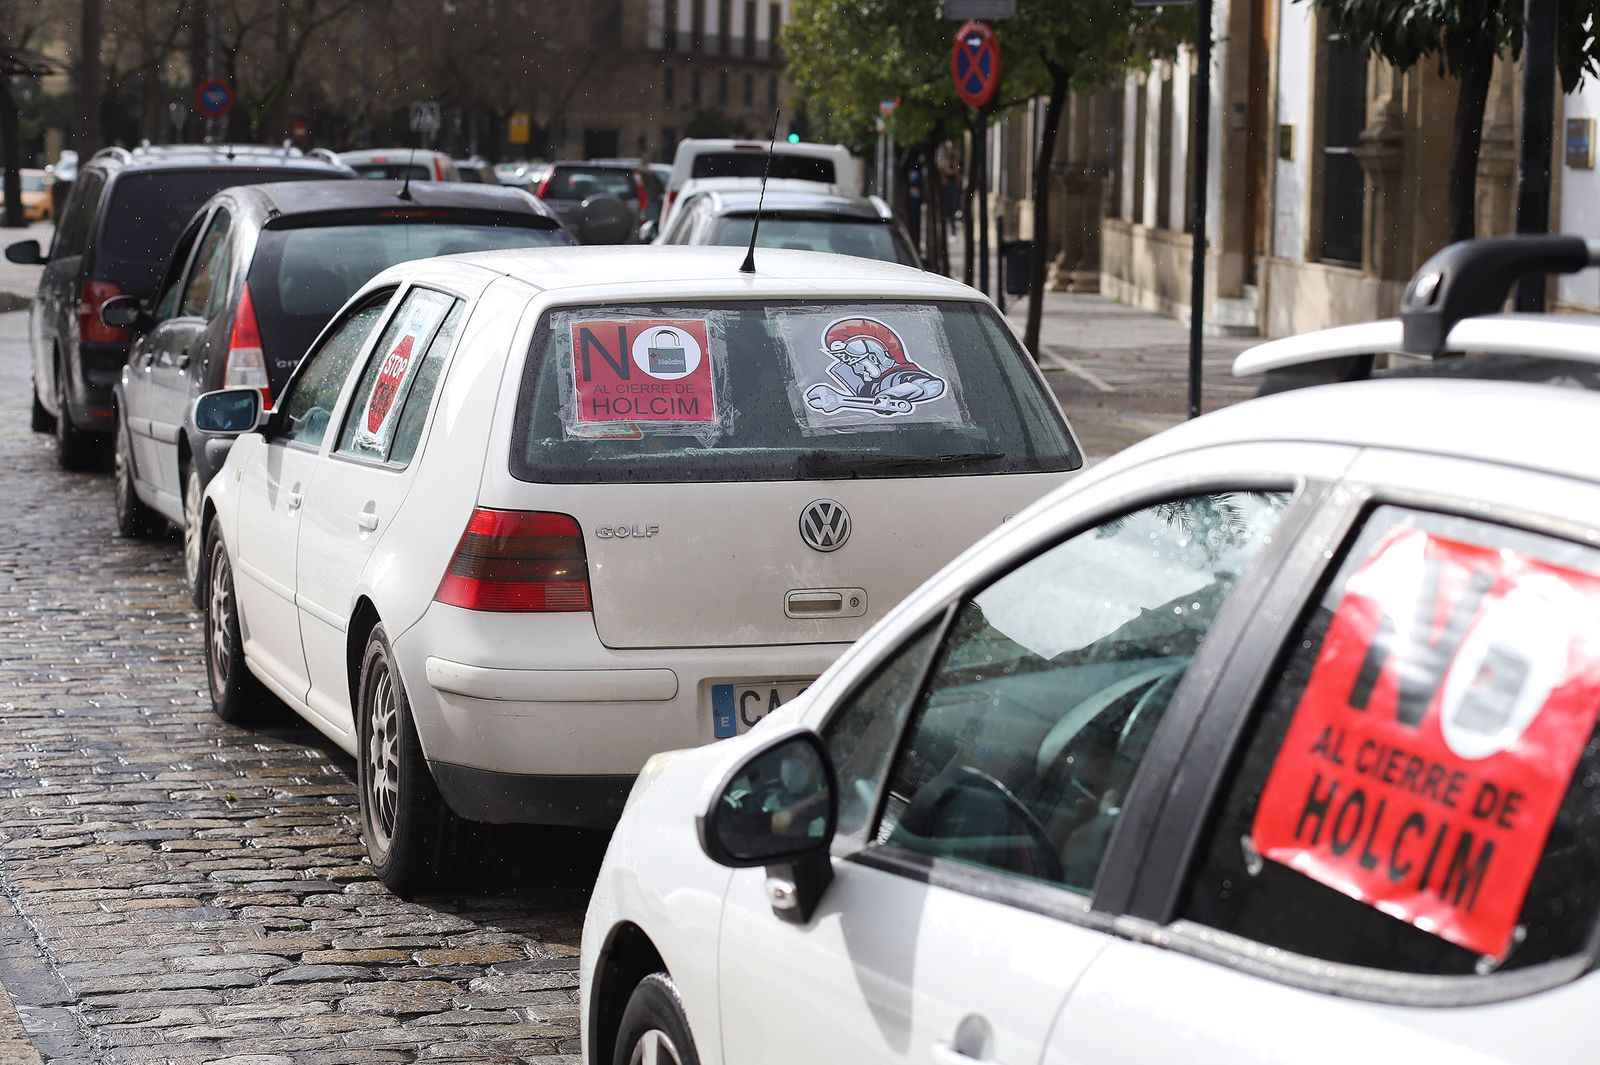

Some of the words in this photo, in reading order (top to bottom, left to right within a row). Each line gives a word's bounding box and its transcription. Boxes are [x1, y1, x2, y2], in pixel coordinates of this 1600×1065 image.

[384, 353, 408, 379] STOP
[593, 384, 611, 394] AL
[615, 384, 669, 394] CIERRE
[675, 384, 695, 393] DE
[592, 397, 699, 416] HOLCIM
[595, 523, 659, 539] GOLF
[721, 716, 730, 728] E
[1310, 725, 1345, 765] AL
[1354, 739, 1469, 807] CIERRE
[1473, 780, 1525, 830] DE
[1293, 773, 1497, 913] HOLCIM
